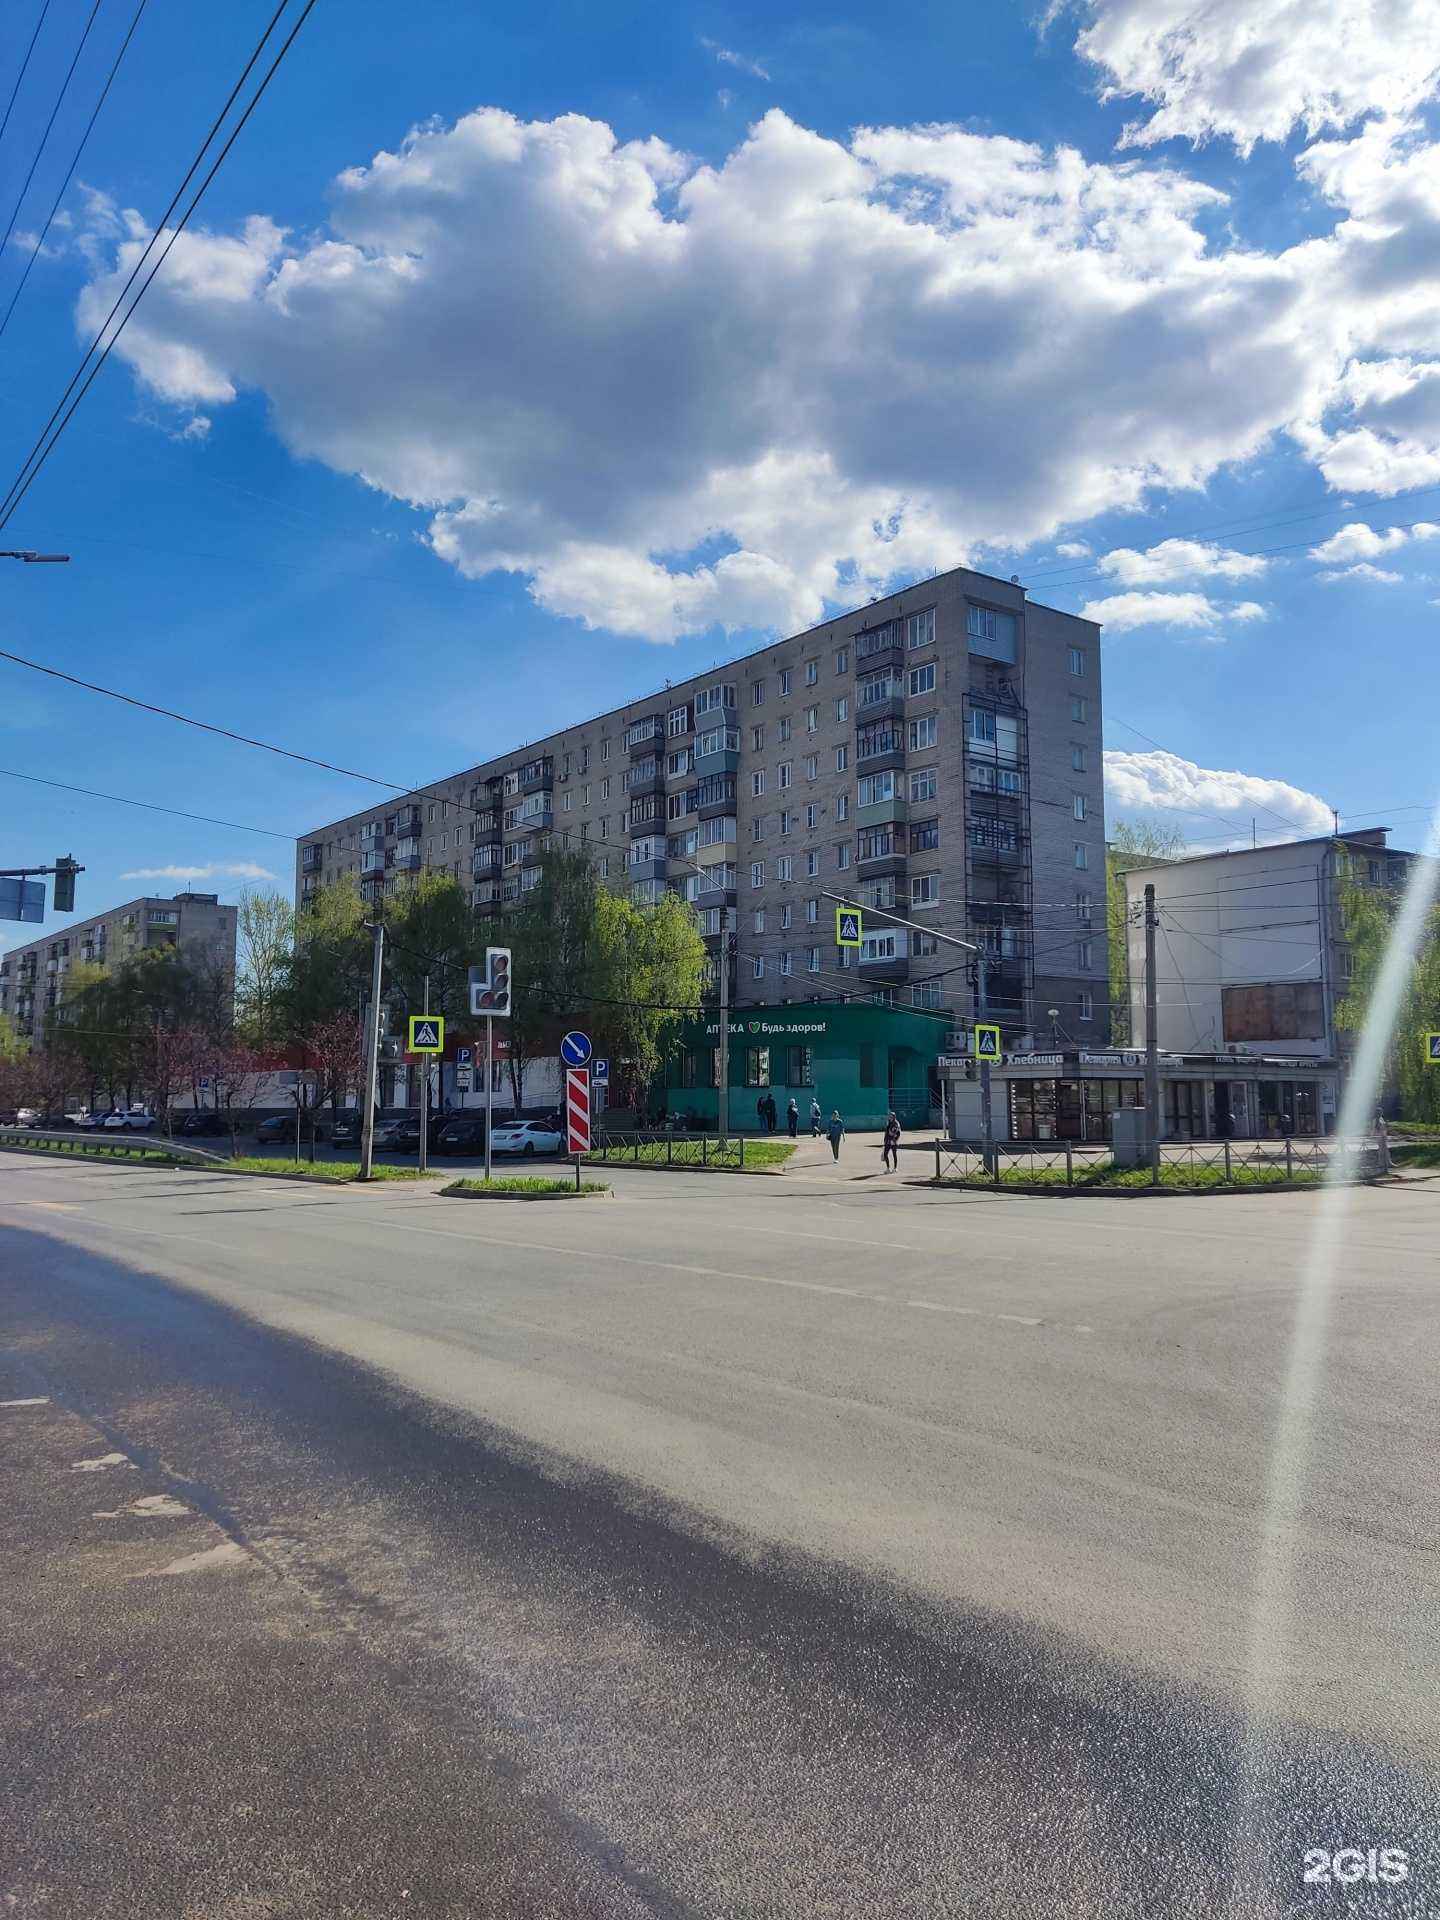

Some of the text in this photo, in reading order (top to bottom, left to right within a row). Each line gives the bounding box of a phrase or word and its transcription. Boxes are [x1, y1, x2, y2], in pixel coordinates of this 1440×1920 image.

[706, 1022, 826, 1034] АПЕКА Будь здоров!
[1007, 1053, 1064, 1066] Хлебница
[596, 1061, 606, 1076] P
